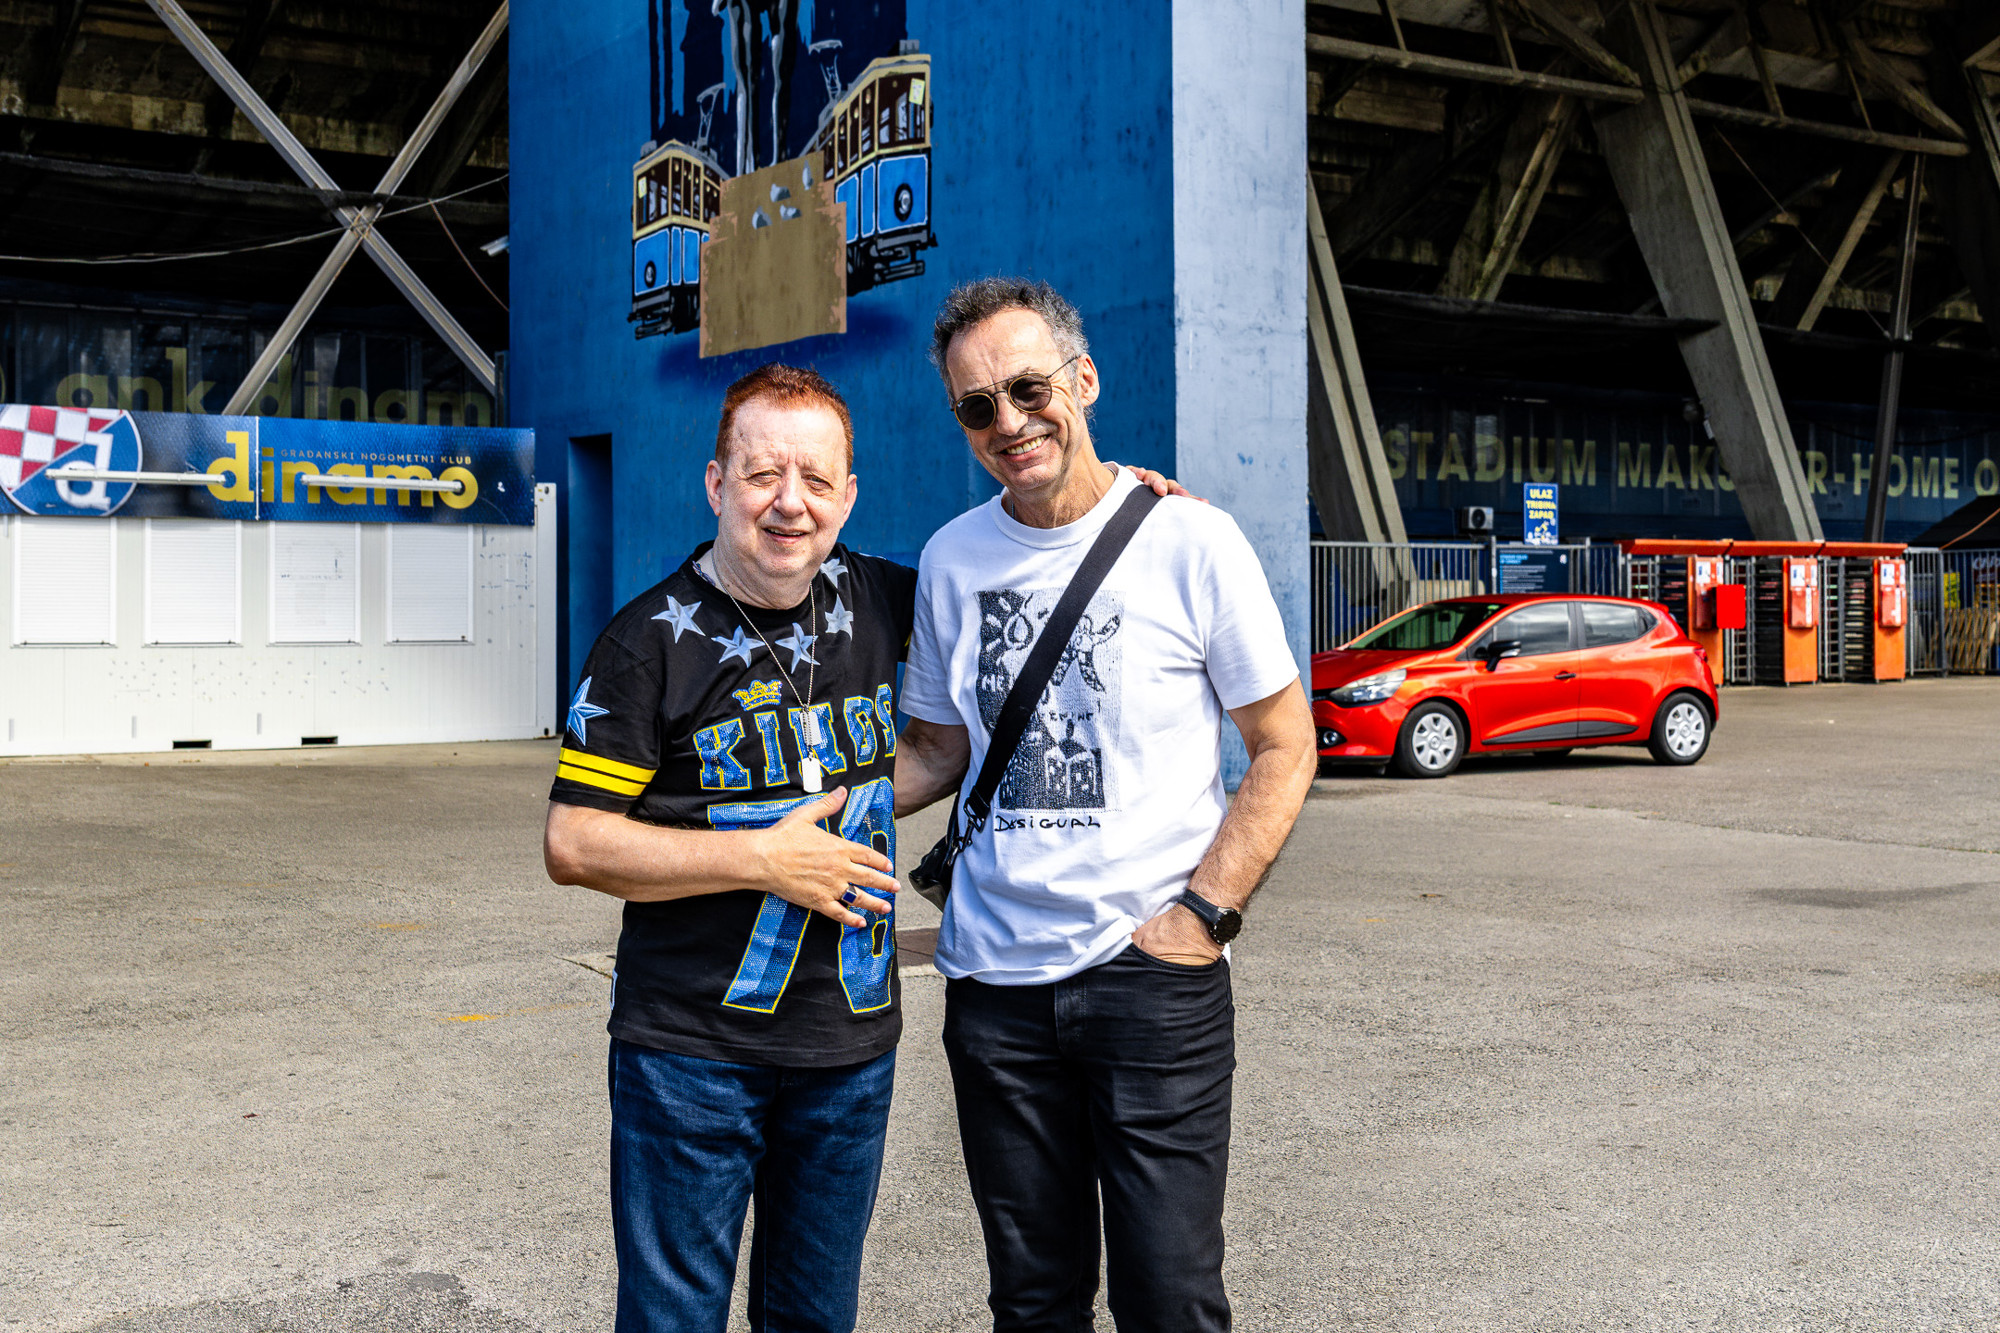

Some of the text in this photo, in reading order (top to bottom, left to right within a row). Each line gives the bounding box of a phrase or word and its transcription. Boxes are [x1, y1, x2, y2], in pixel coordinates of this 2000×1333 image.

[361, 453, 435, 464] NOGOMETNI
[440, 455, 472, 465] KLUB
[1383, 429, 1597, 487] STADIUM
[207, 430, 479, 509] dinamo
[1530, 489, 1554, 499] ULAZ
[1526, 500, 1557, 510] TRIBINA
[1529, 510, 1554, 519] ZAPAD
